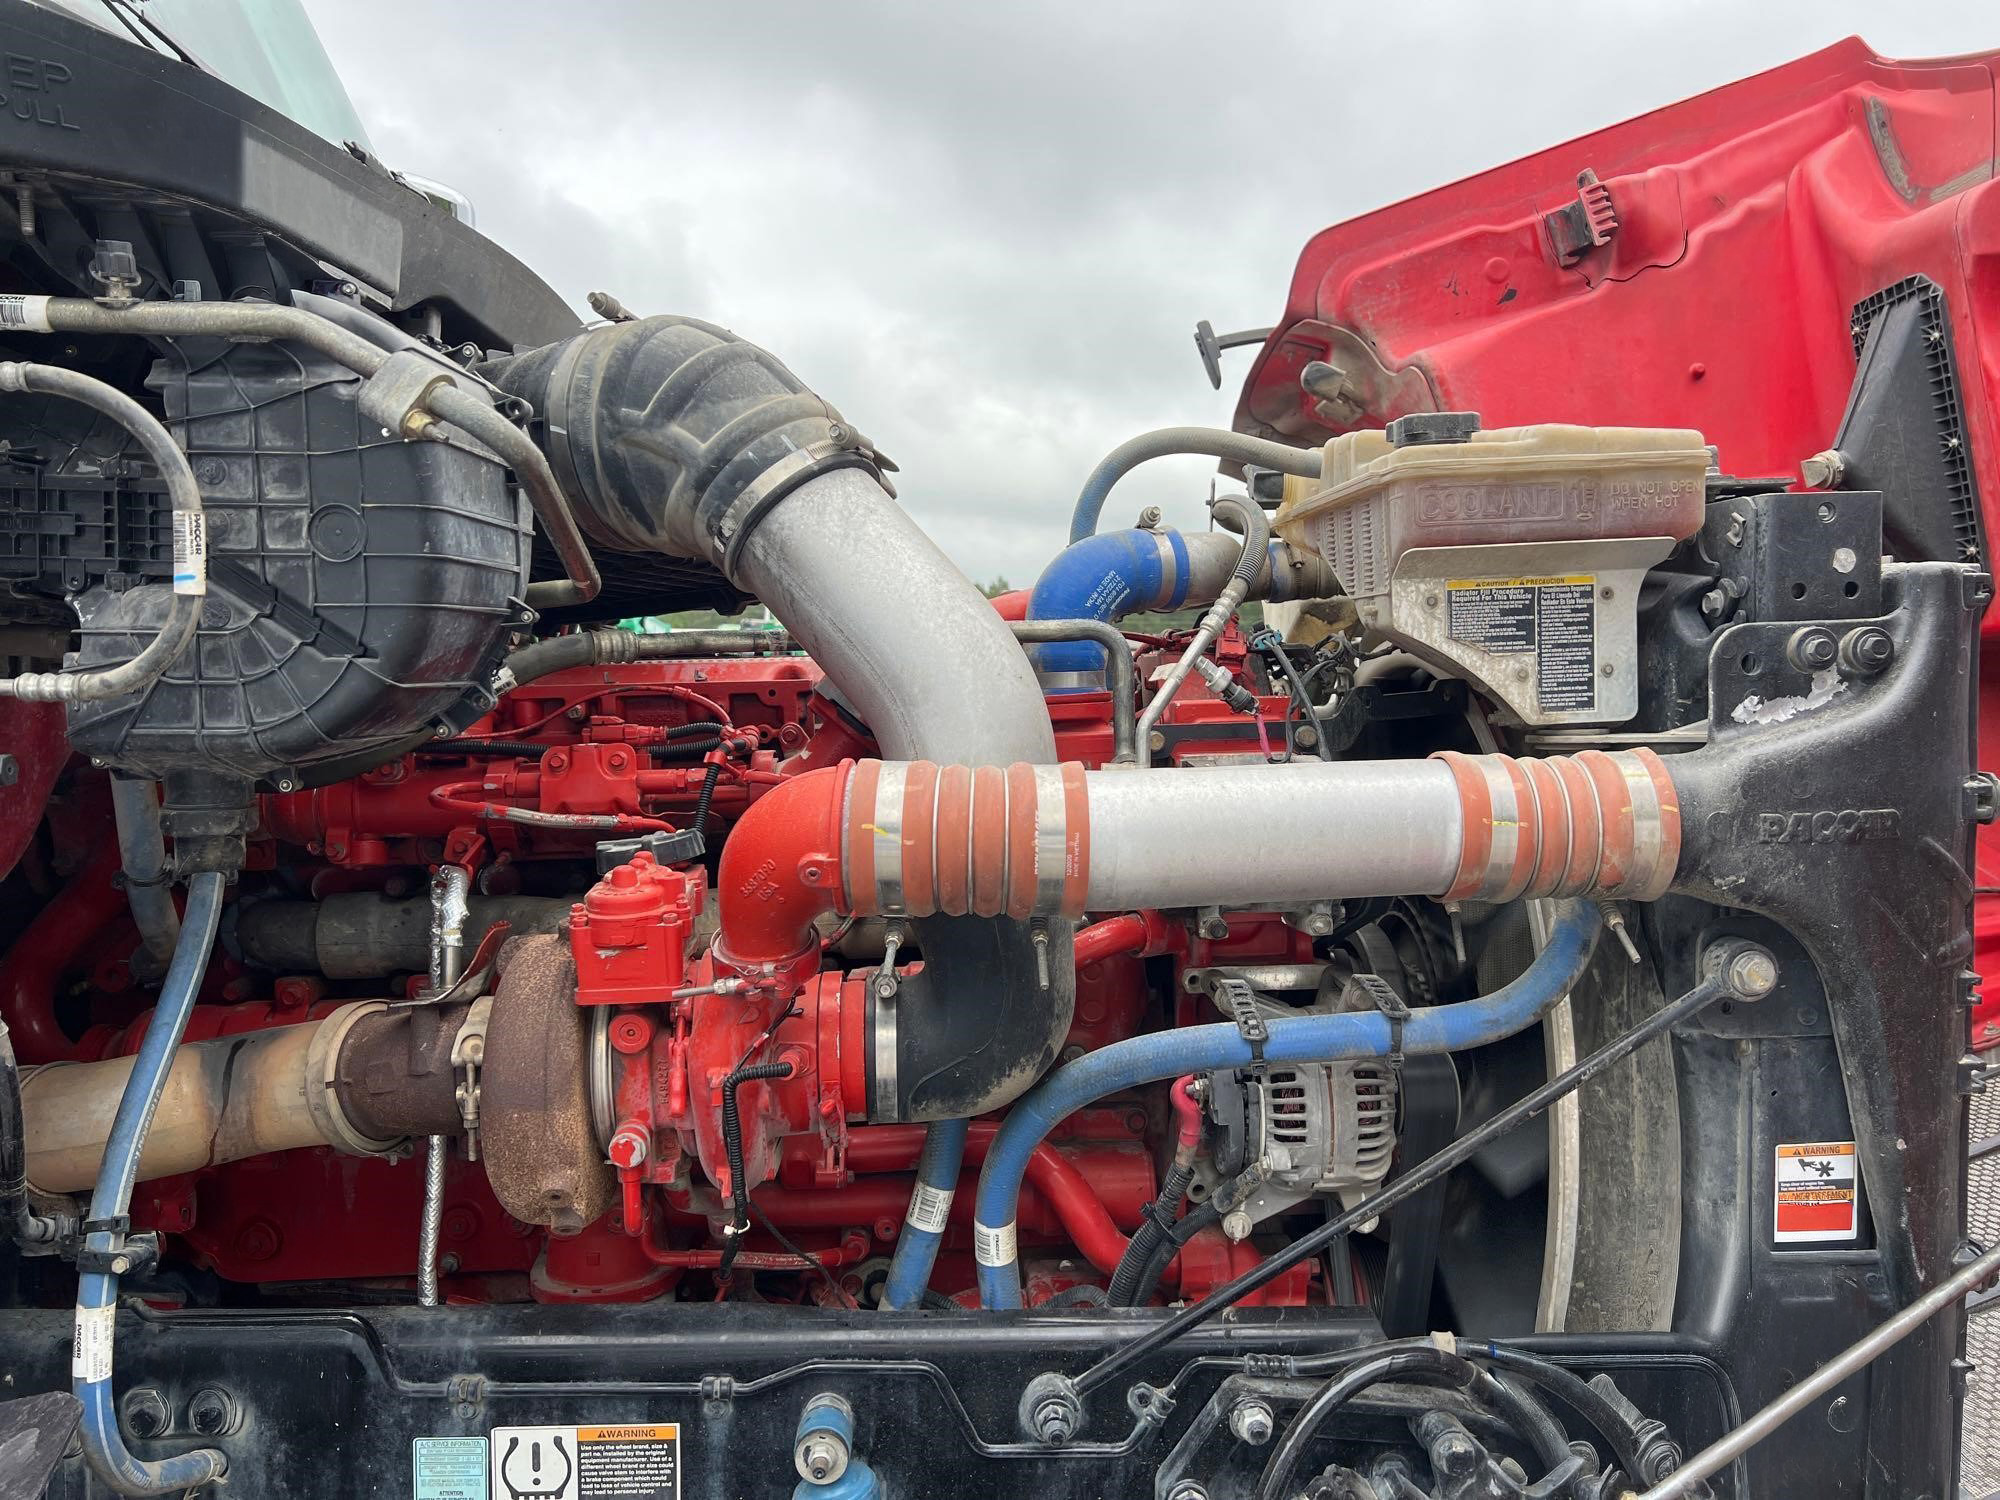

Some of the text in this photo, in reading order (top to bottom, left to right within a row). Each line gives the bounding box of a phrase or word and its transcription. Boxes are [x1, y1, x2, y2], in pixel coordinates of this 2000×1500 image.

[1610, 480, 1701, 495] DO NOT OPEN
[1421, 487, 1558, 519] COOLANT
[1612, 496, 1679, 510] WHEN HOT
[194, 514, 202, 555] PACCAR
[1101, 570, 1116, 587] MADE
[1759, 808, 1903, 845] PACCAR
[757, 880, 779, 901] USA
[1803, 1146, 1840, 1154] WARNING
[606, 1429, 656, 1438] WARNING
